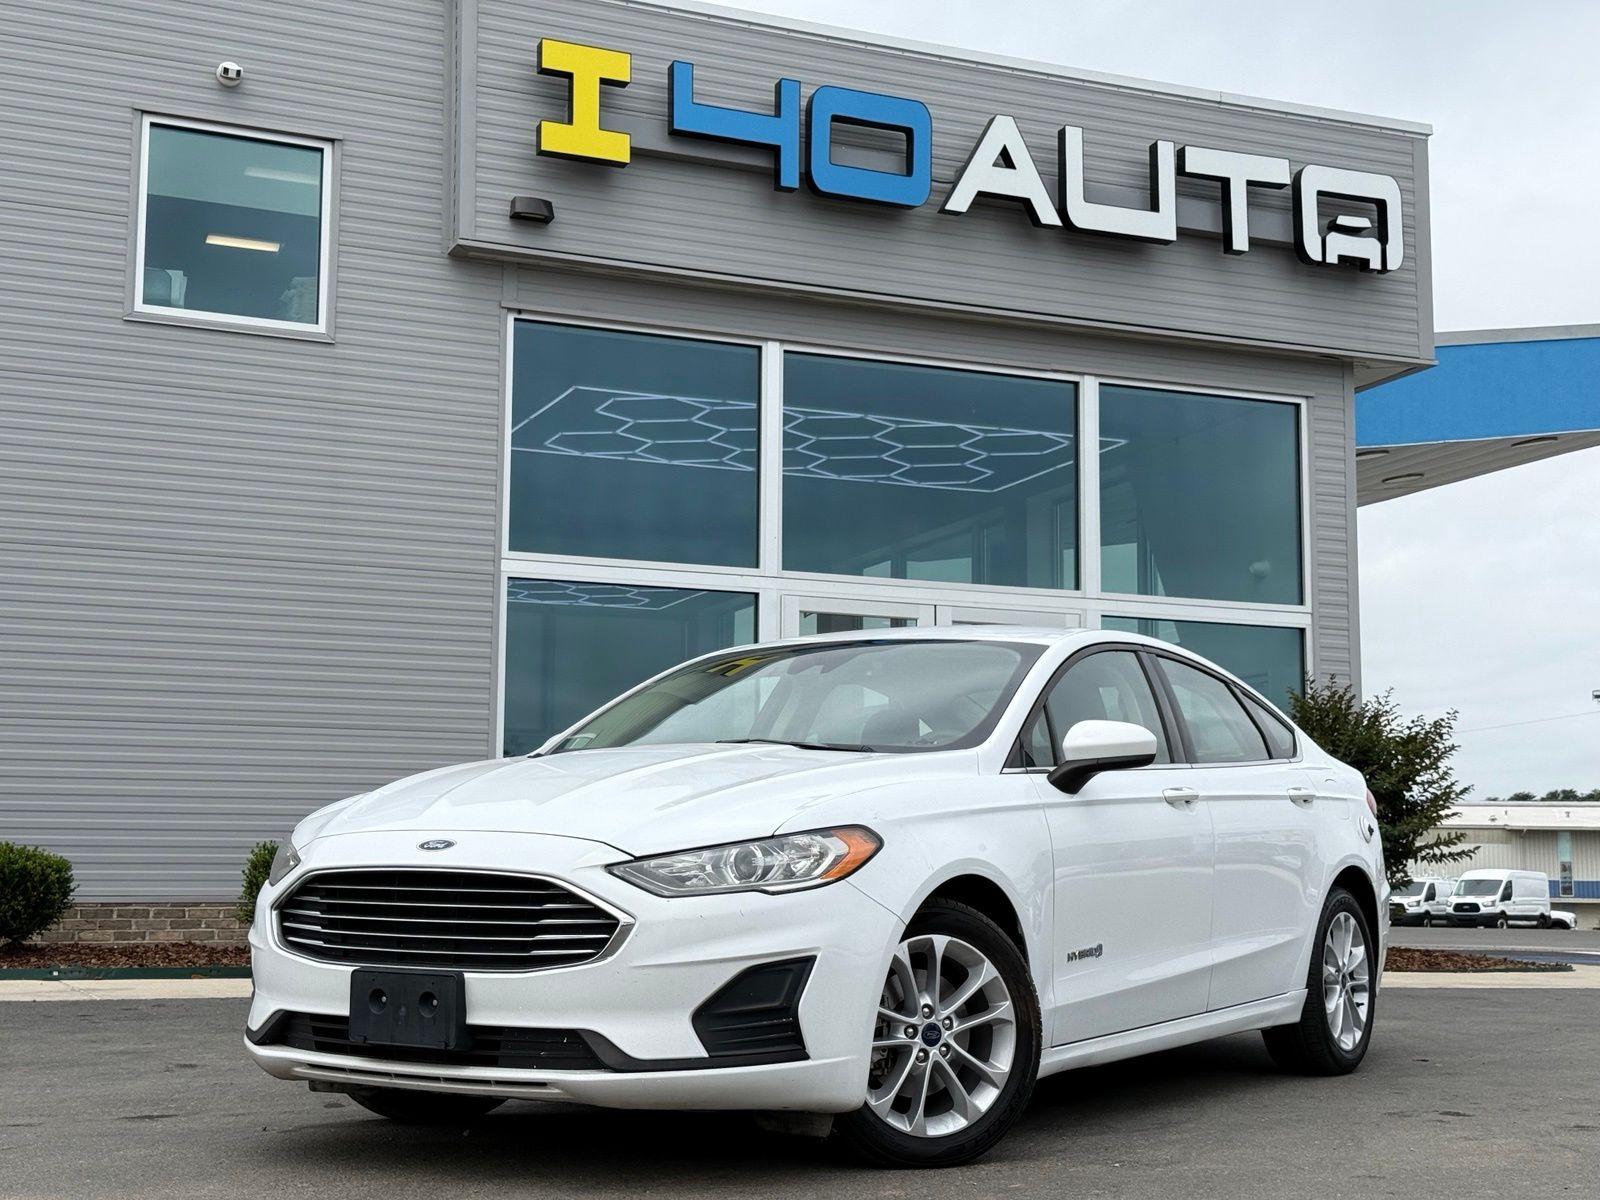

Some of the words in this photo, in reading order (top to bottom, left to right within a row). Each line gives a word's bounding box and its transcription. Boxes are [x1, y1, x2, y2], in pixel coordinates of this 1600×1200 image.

[537, 38, 632, 168] I
[668, 60, 932, 208] 40
[943, 114, 1404, 272] AUTO
